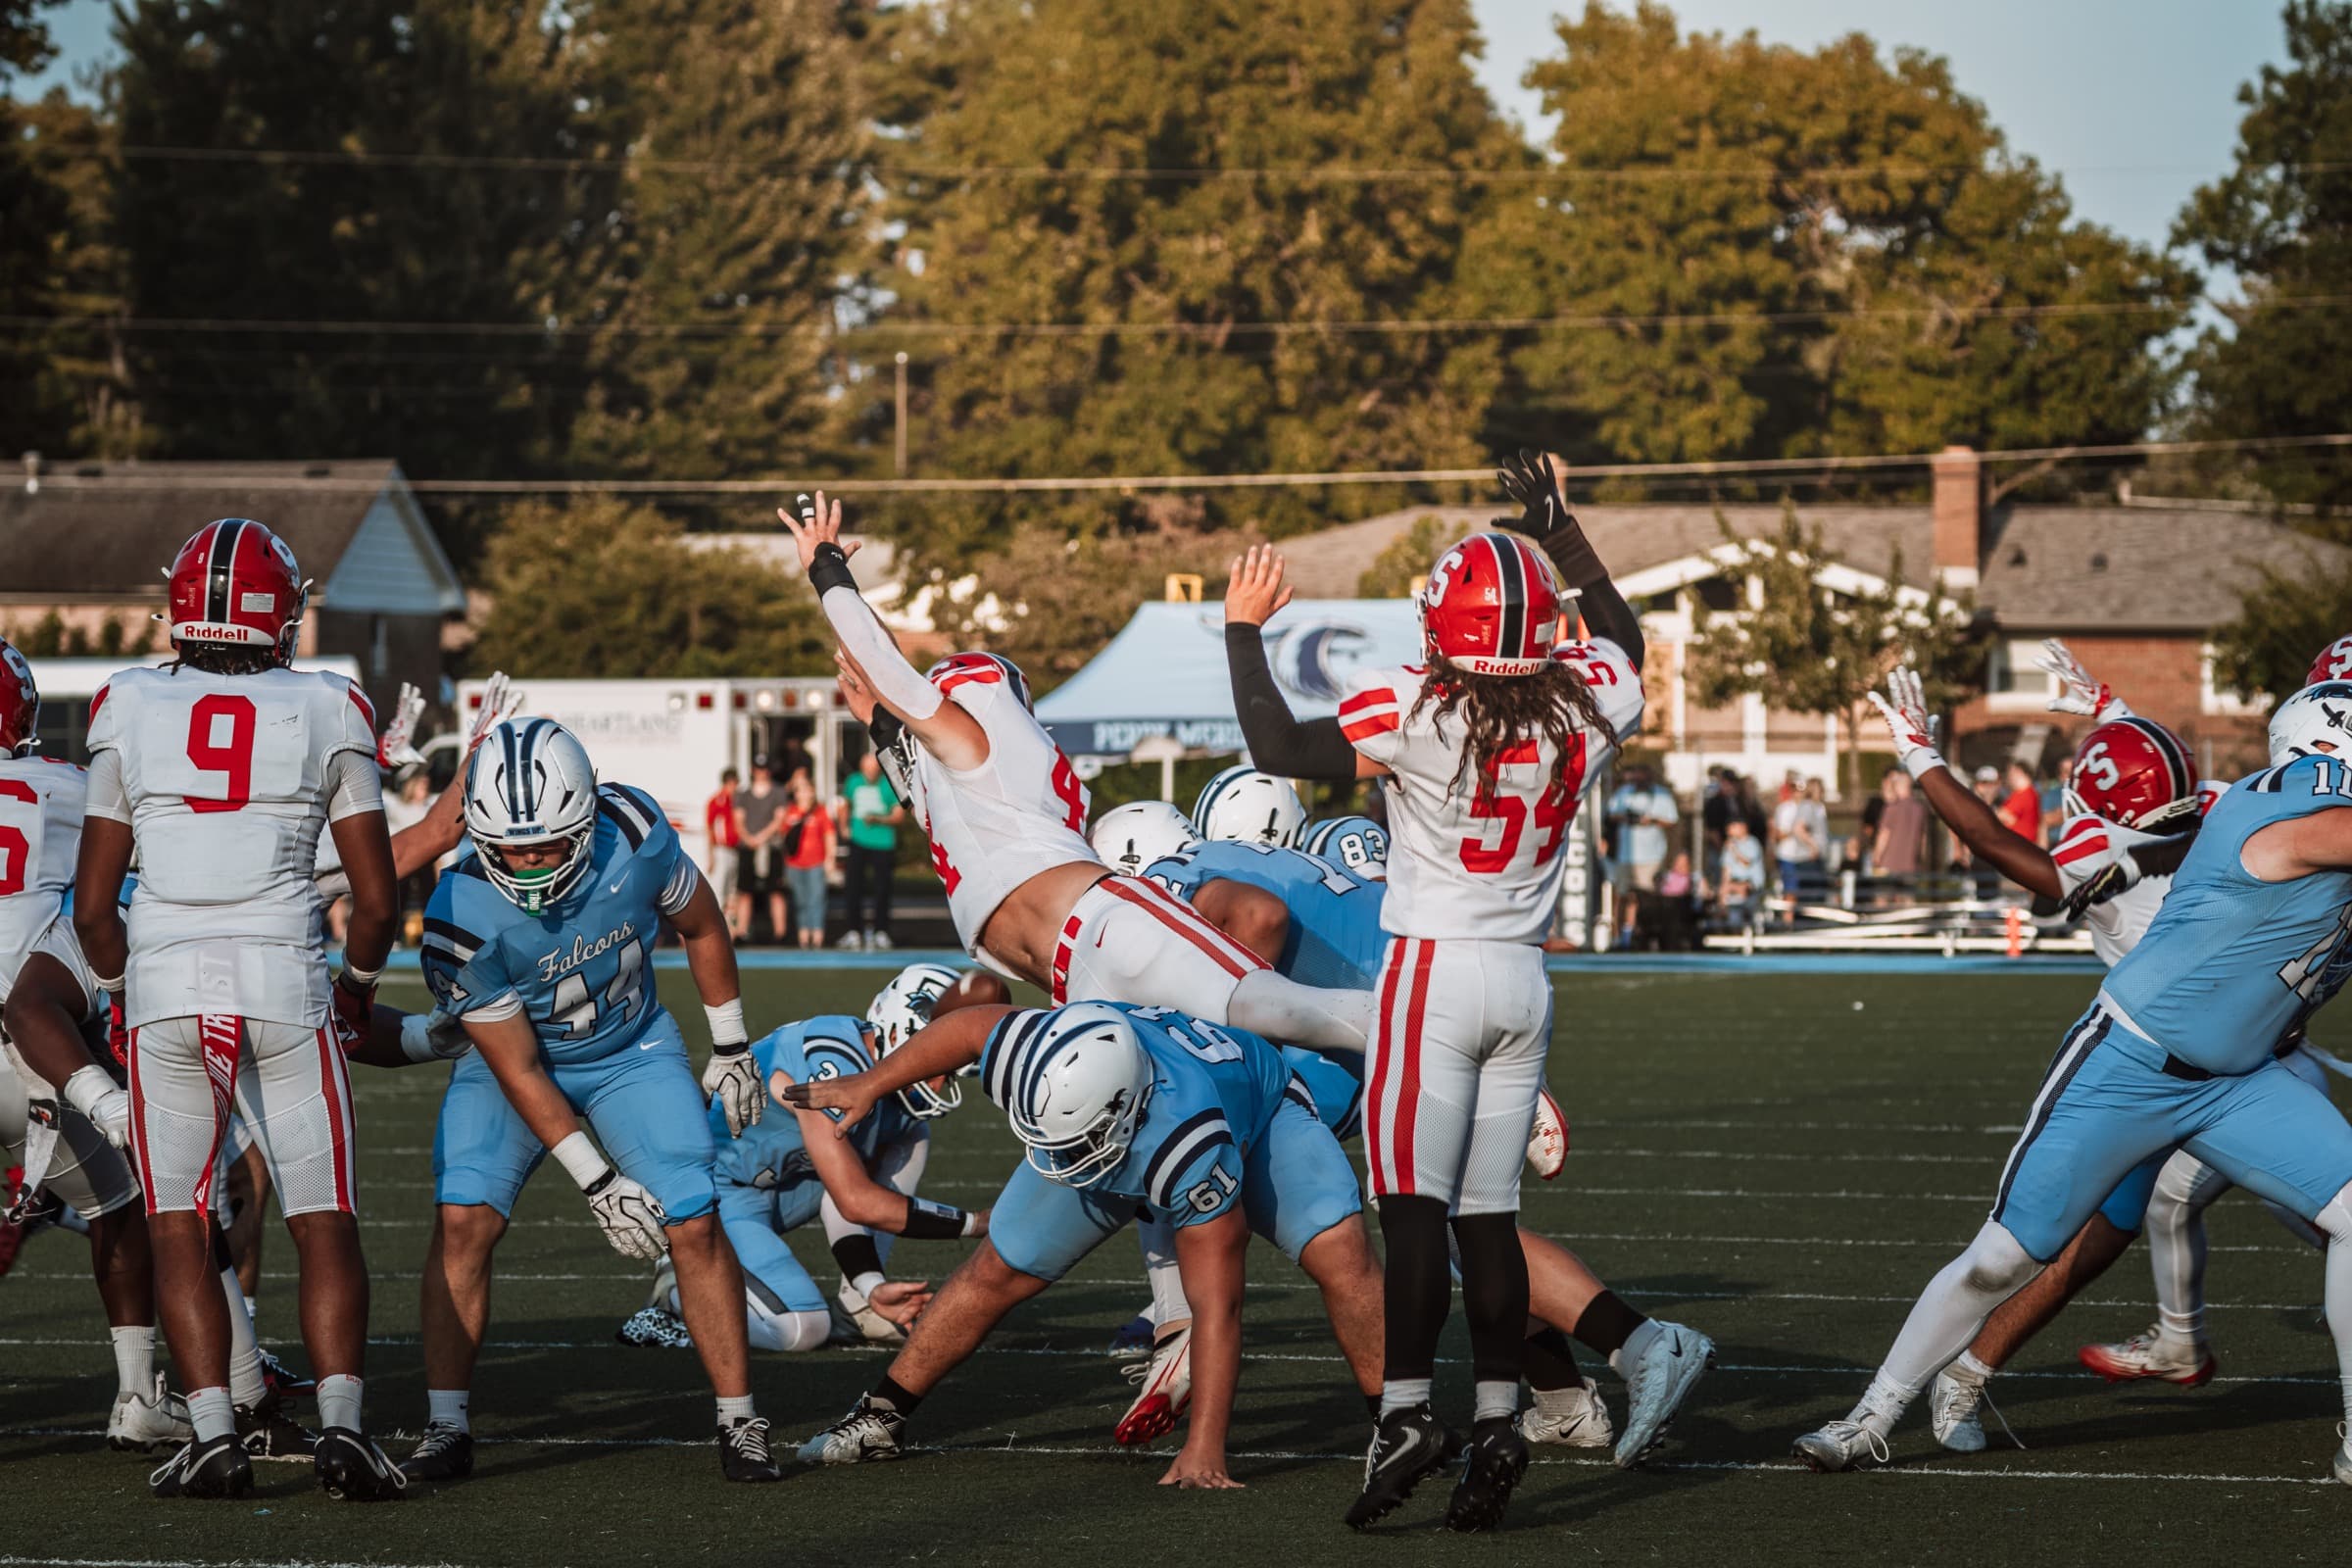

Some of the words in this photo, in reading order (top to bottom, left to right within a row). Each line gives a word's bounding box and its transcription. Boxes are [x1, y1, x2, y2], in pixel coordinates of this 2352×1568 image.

[1427, 551, 1464, 608] S
[184, 625, 249, 642] Riddell
[1474, 660, 1540, 675] Riddell
[183, 693, 257, 813] 9
[2084, 742, 2120, 791] S
[1459, 732, 1586, 873] 54
[1339, 828, 1387, 869] 83
[537, 921, 636, 983] Falcons
[548, 936, 645, 1041] 44
[1186, 1161, 1239, 1213] 61
